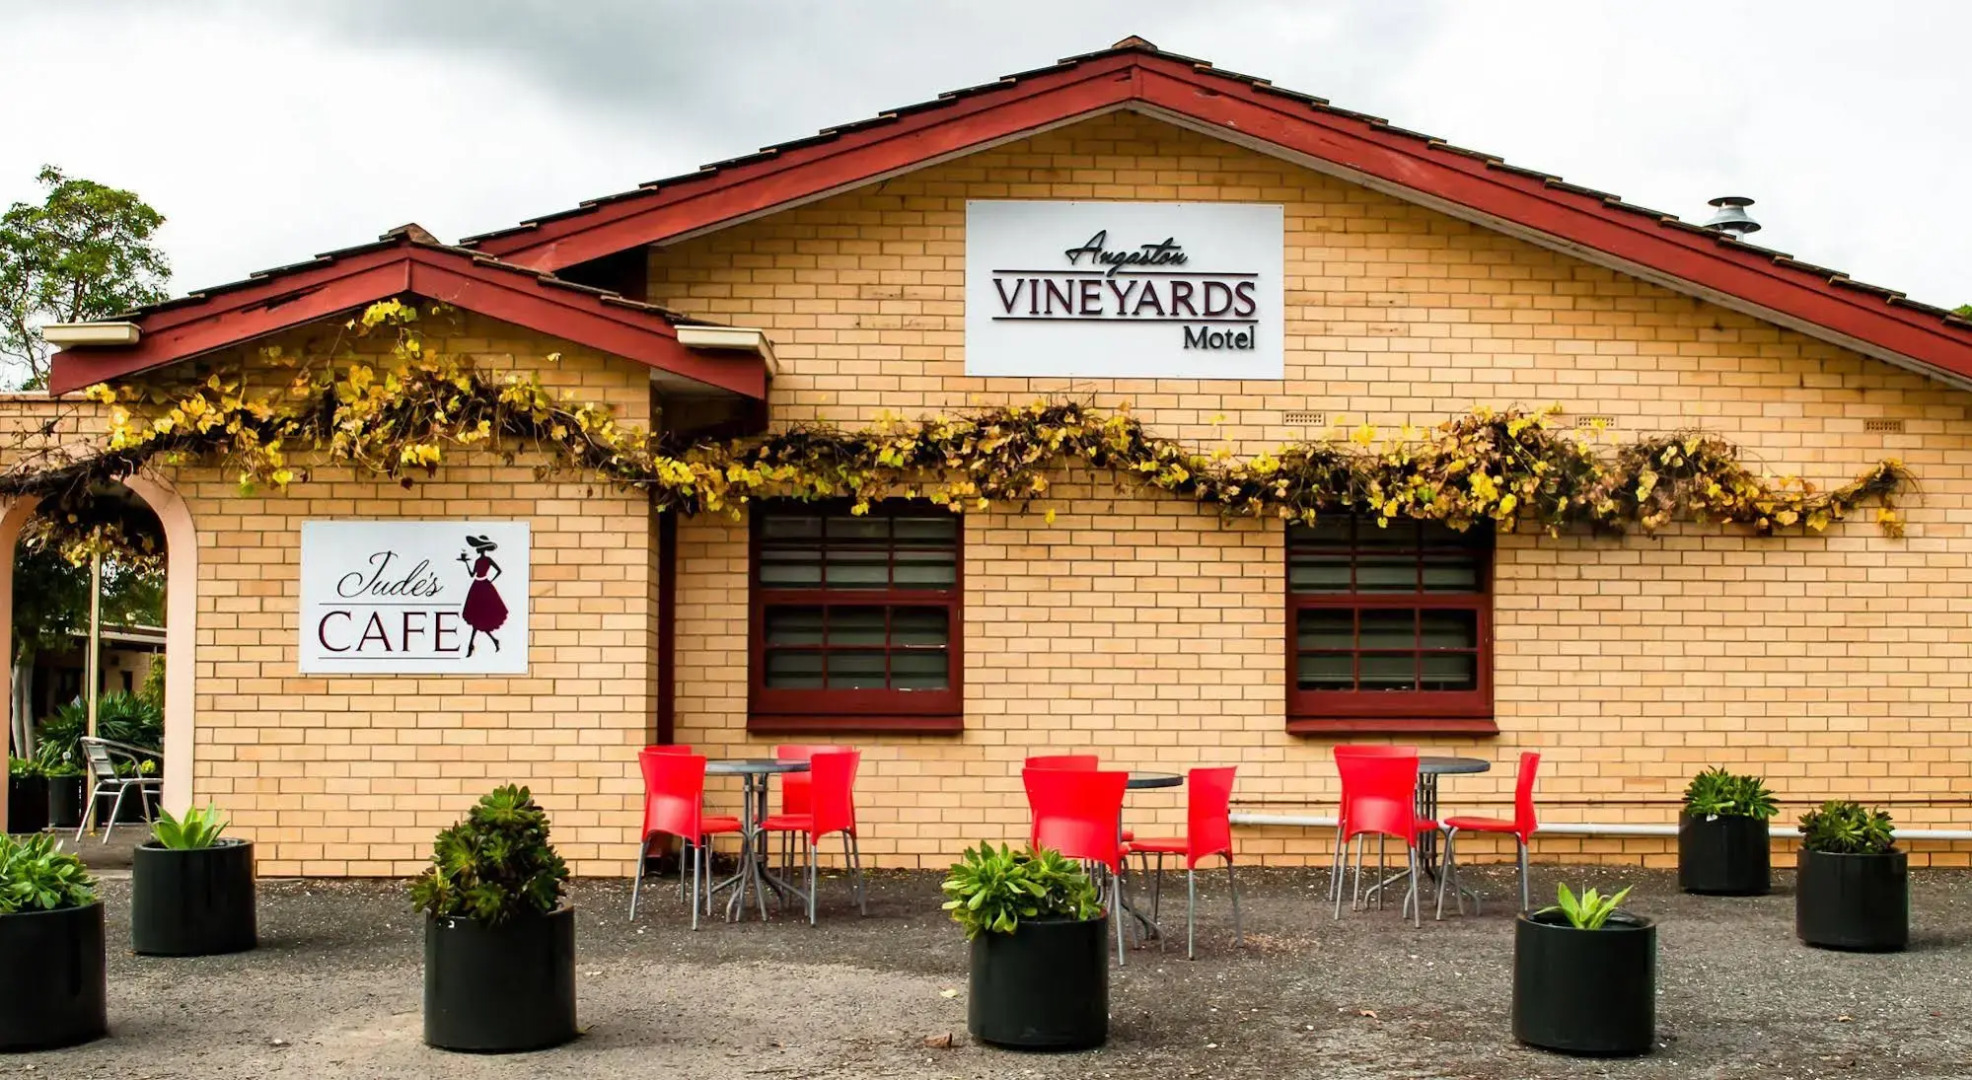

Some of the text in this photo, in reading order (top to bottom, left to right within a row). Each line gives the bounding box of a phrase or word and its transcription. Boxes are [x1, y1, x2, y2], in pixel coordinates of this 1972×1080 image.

[1065, 229, 1188, 277] Angaston
[993, 279, 1256, 317] VINEYARDS
[1183, 325, 1255, 349] Motel
[337, 550, 444, 598] Jude's
[318, 611, 461, 652] CAFE
